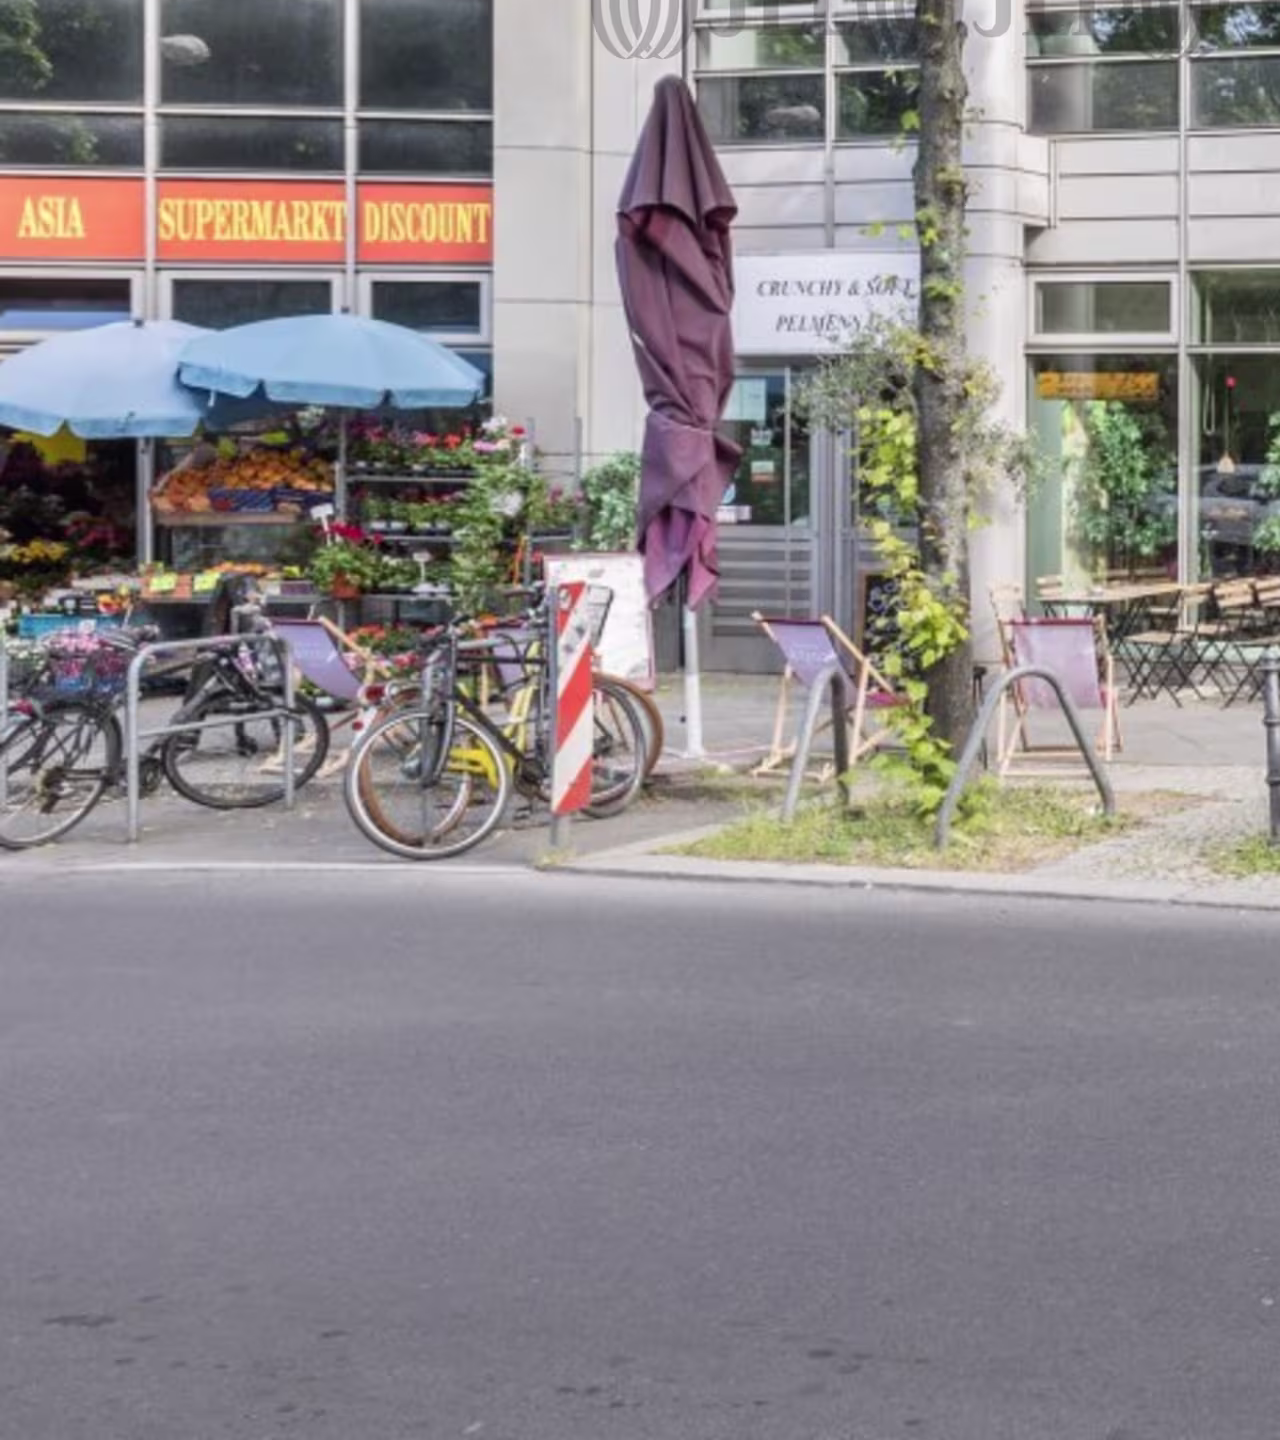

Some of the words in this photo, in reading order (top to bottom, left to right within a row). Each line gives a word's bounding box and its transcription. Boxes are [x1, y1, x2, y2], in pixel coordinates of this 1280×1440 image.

[17, 196, 85, 239] ASIA
[159, 198, 348, 243] SUPERMARKT
[364, 202, 490, 244] DISCOUNT
[756, 278, 842, 297] CRUNCHY
[847, 278, 860, 297] &
